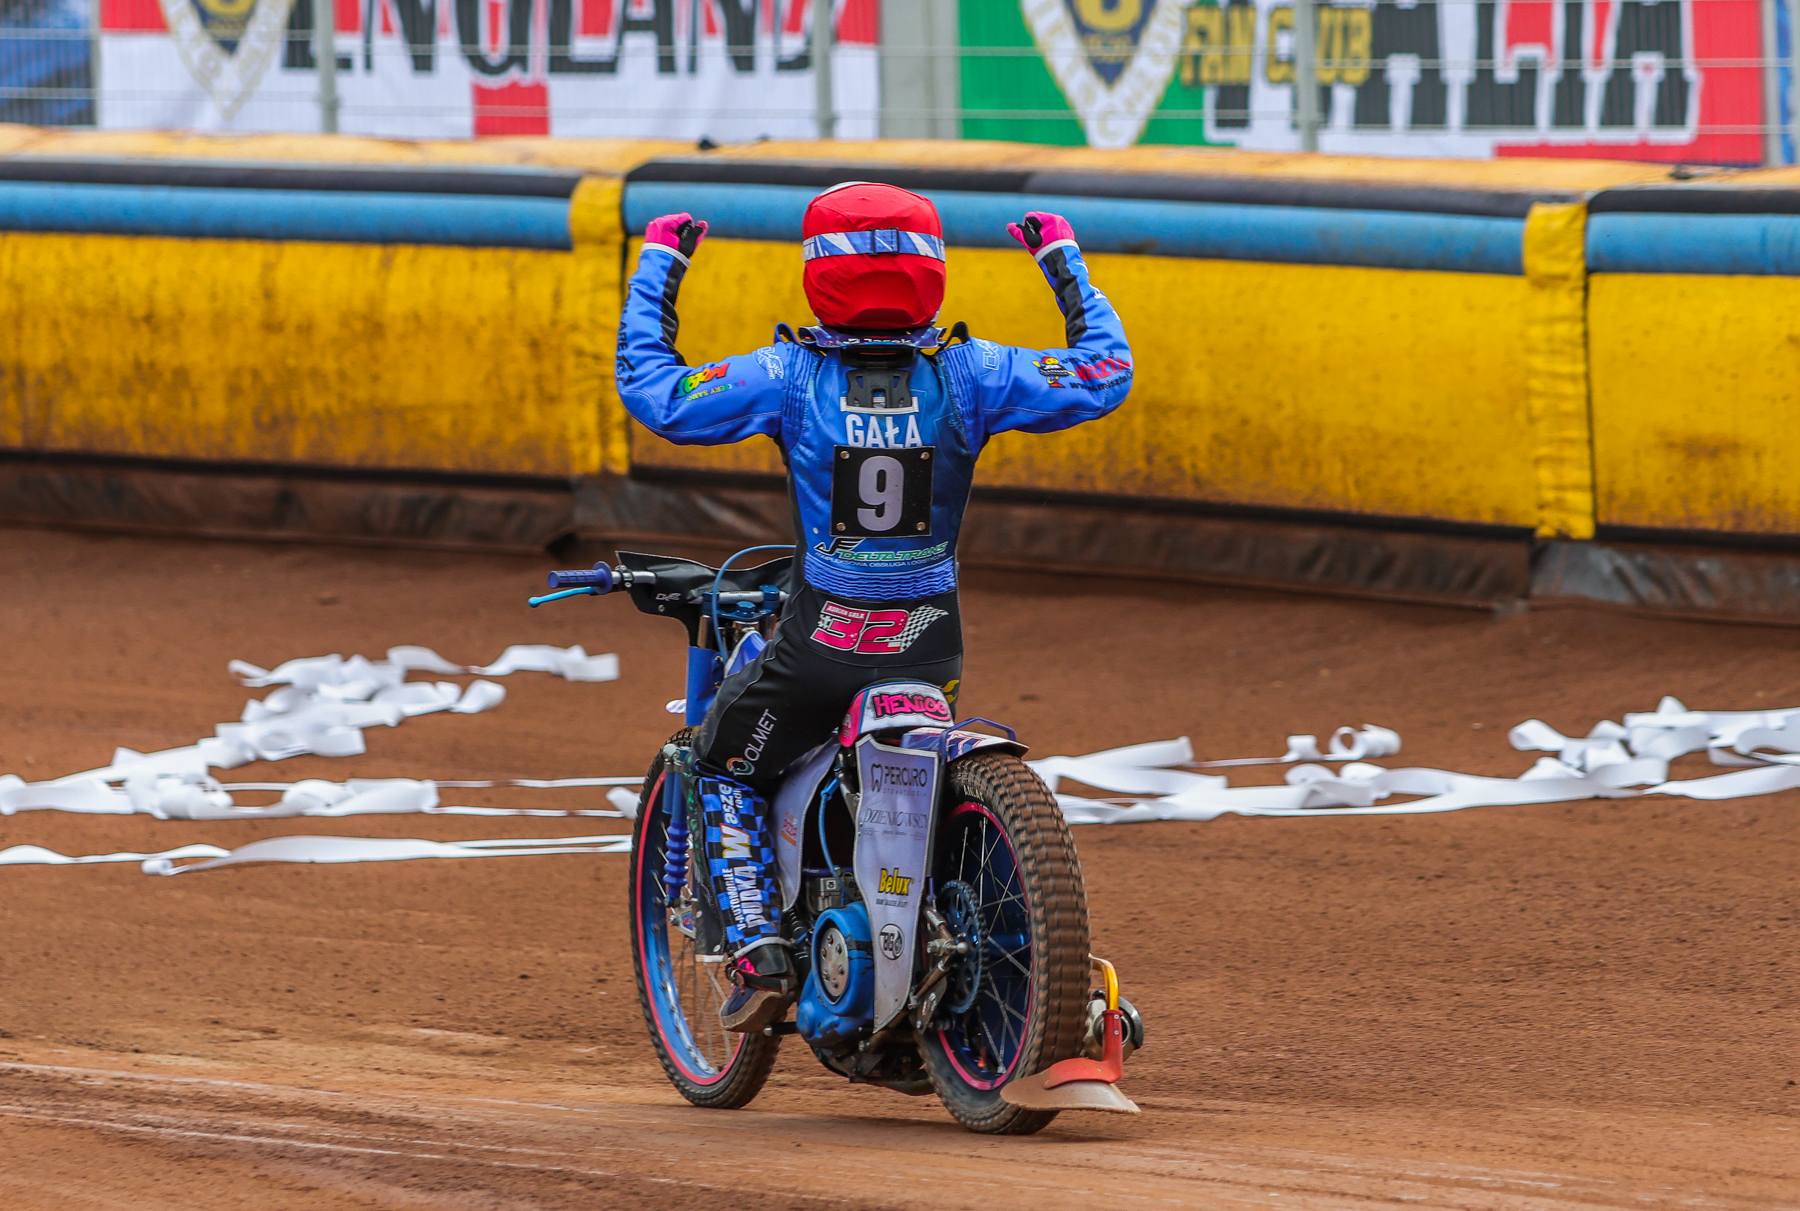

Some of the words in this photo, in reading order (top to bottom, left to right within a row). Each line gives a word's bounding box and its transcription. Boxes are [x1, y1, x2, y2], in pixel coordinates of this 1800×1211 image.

[1266, 6, 1372, 87] CUB
[845, 413, 923, 448] GAŁA
[857, 455, 904, 532] 9
[811, 601, 910, 655] 32
[744, 708, 778, 761] OLMET
[883, 765, 928, 788] PERCURO
[733, 865, 769, 929] DUDKA
[878, 867, 912, 896] Belux
